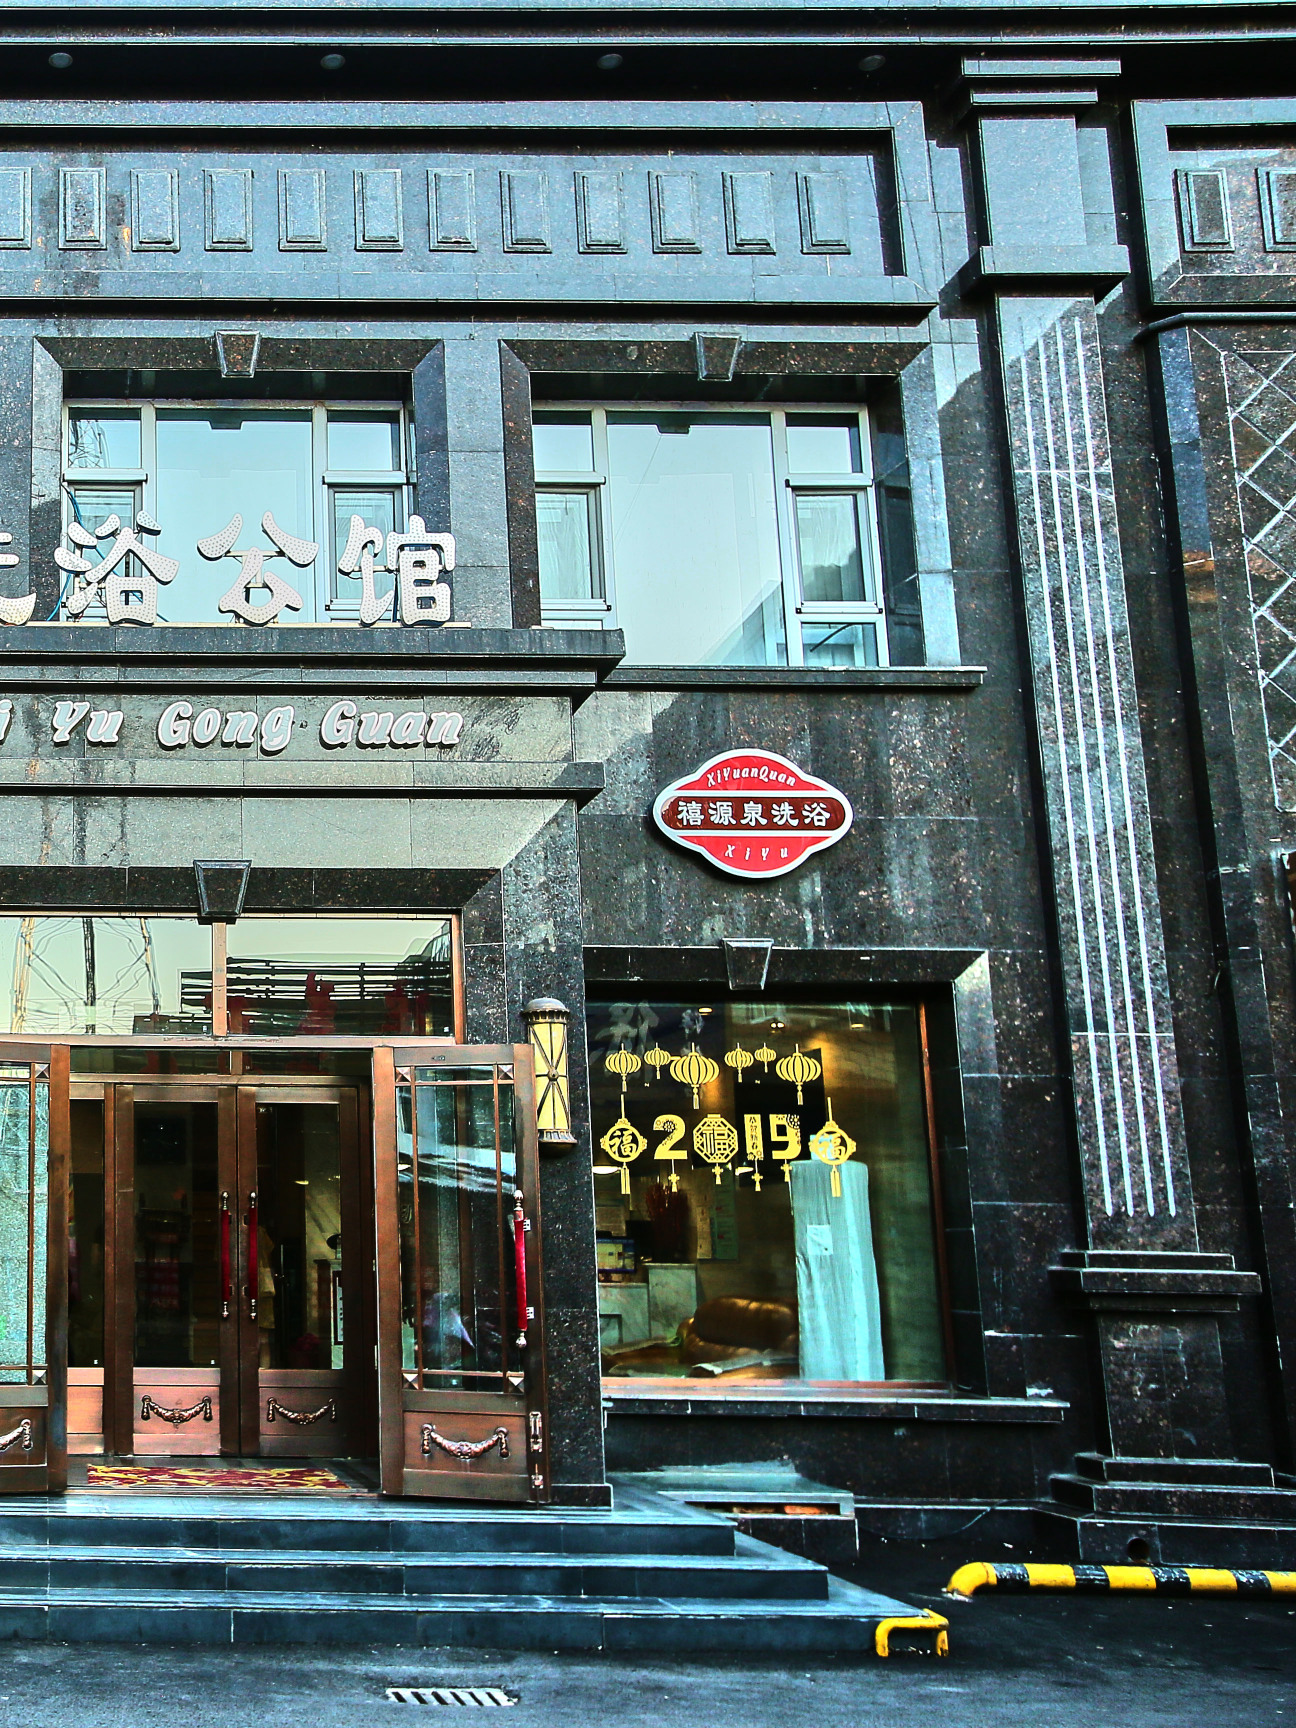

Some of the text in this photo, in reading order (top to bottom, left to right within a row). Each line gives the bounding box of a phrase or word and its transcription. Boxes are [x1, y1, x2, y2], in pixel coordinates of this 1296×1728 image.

[51, 699, 123, 746] Yu
[157, 699, 296, 754] Gong
[320, 699, 463, 748] Guan
[677, 800, 831, 827] 禧源泉洗浴
